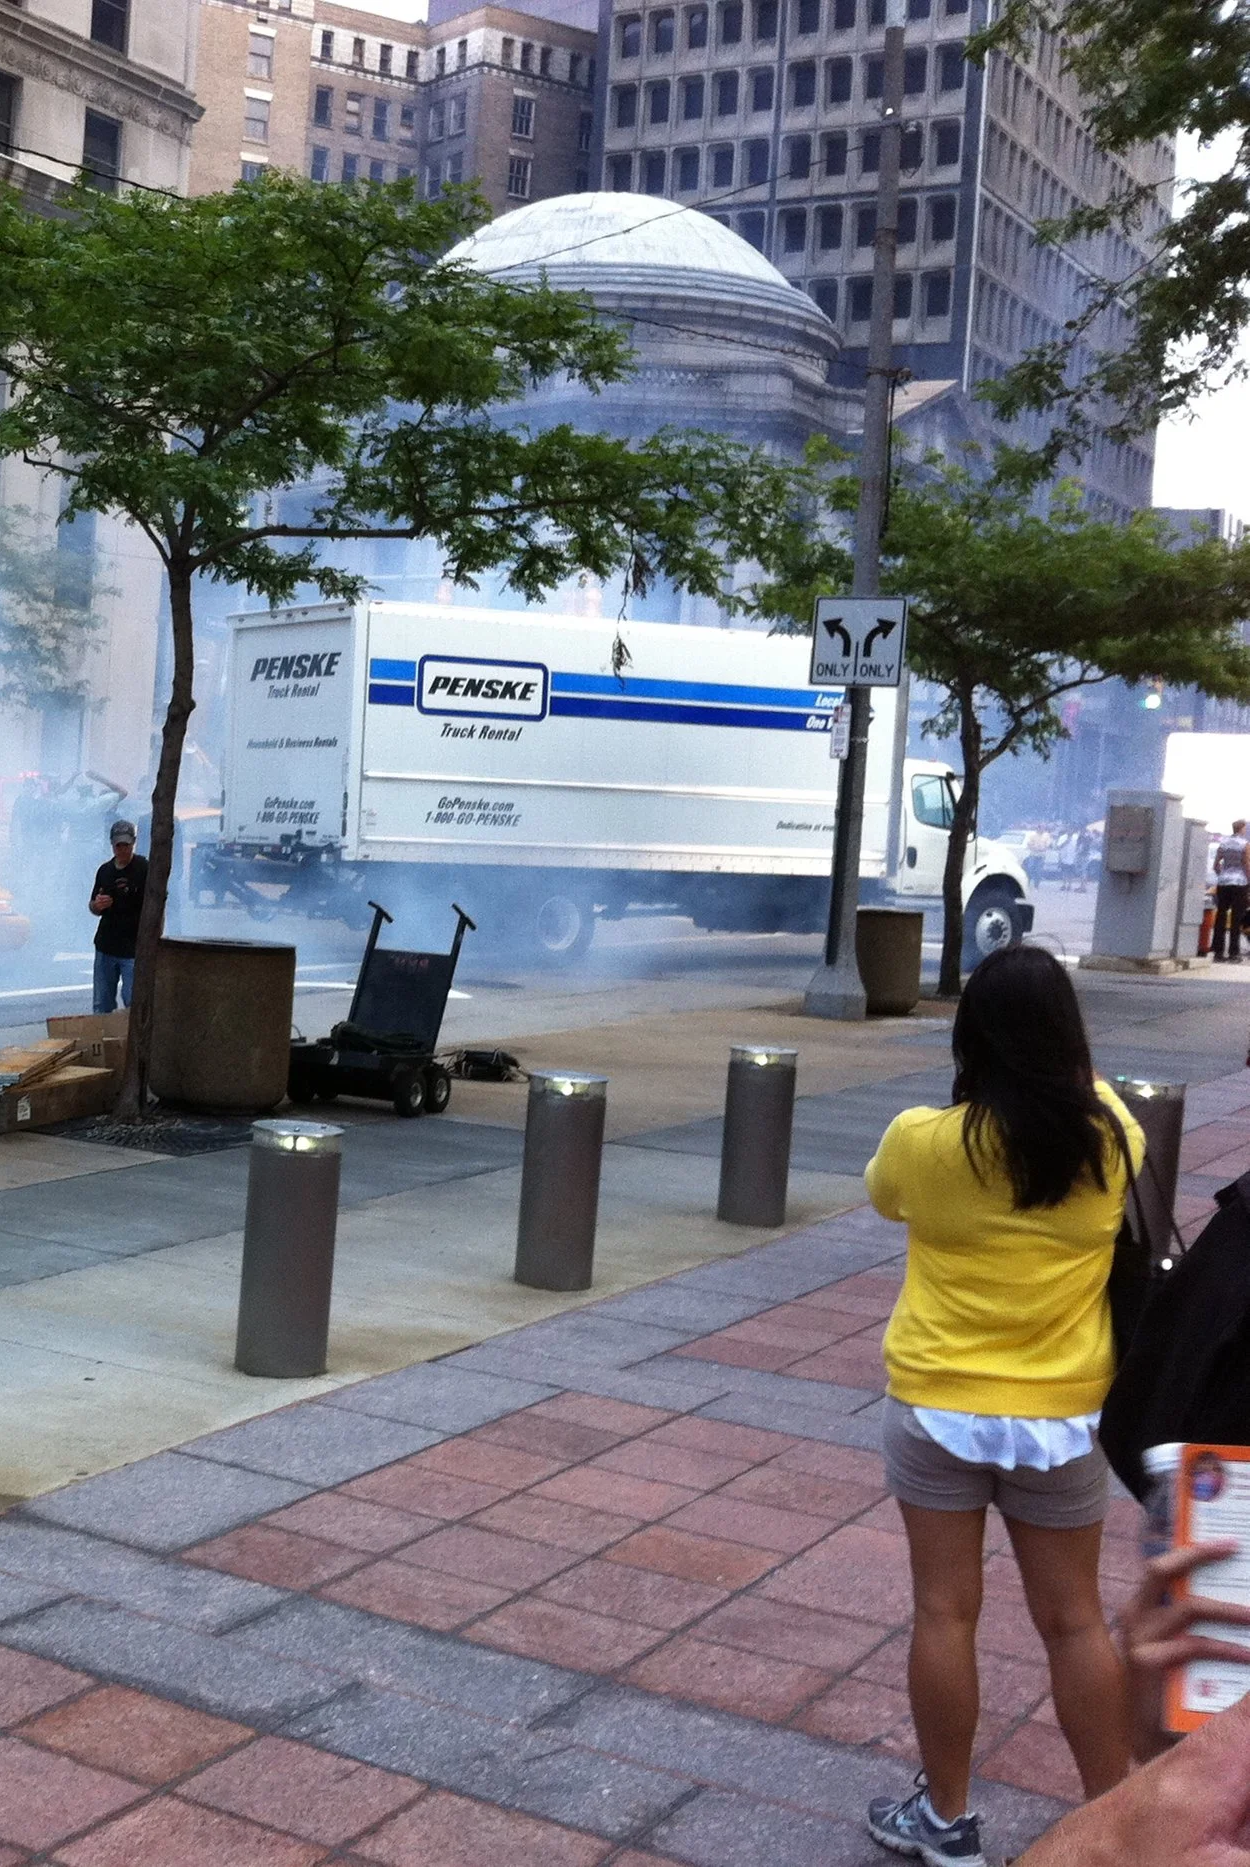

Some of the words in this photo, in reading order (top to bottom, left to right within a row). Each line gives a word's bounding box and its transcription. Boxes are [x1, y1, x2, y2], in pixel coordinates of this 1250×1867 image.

[250, 652, 342, 682] PENSKE
[816, 663, 850, 677] ONLY
[860, 664, 894, 677] ONLY
[267, 685, 291, 699] Truck
[291, 682, 321, 698] Rental
[428, 676, 538, 701] PENSKE
[806, 716, 827, 730] One
[440, 723, 477, 739] Truck
[478, 725, 523, 741] Rental
[264, 797, 317, 809] GoPenske.com
[438, 796, 515, 812] GoPenske.com
[256, 811, 321, 824] 1-800-GO-PENSKE
[425, 811, 522, 827] 1-800-GO-PENSKE
